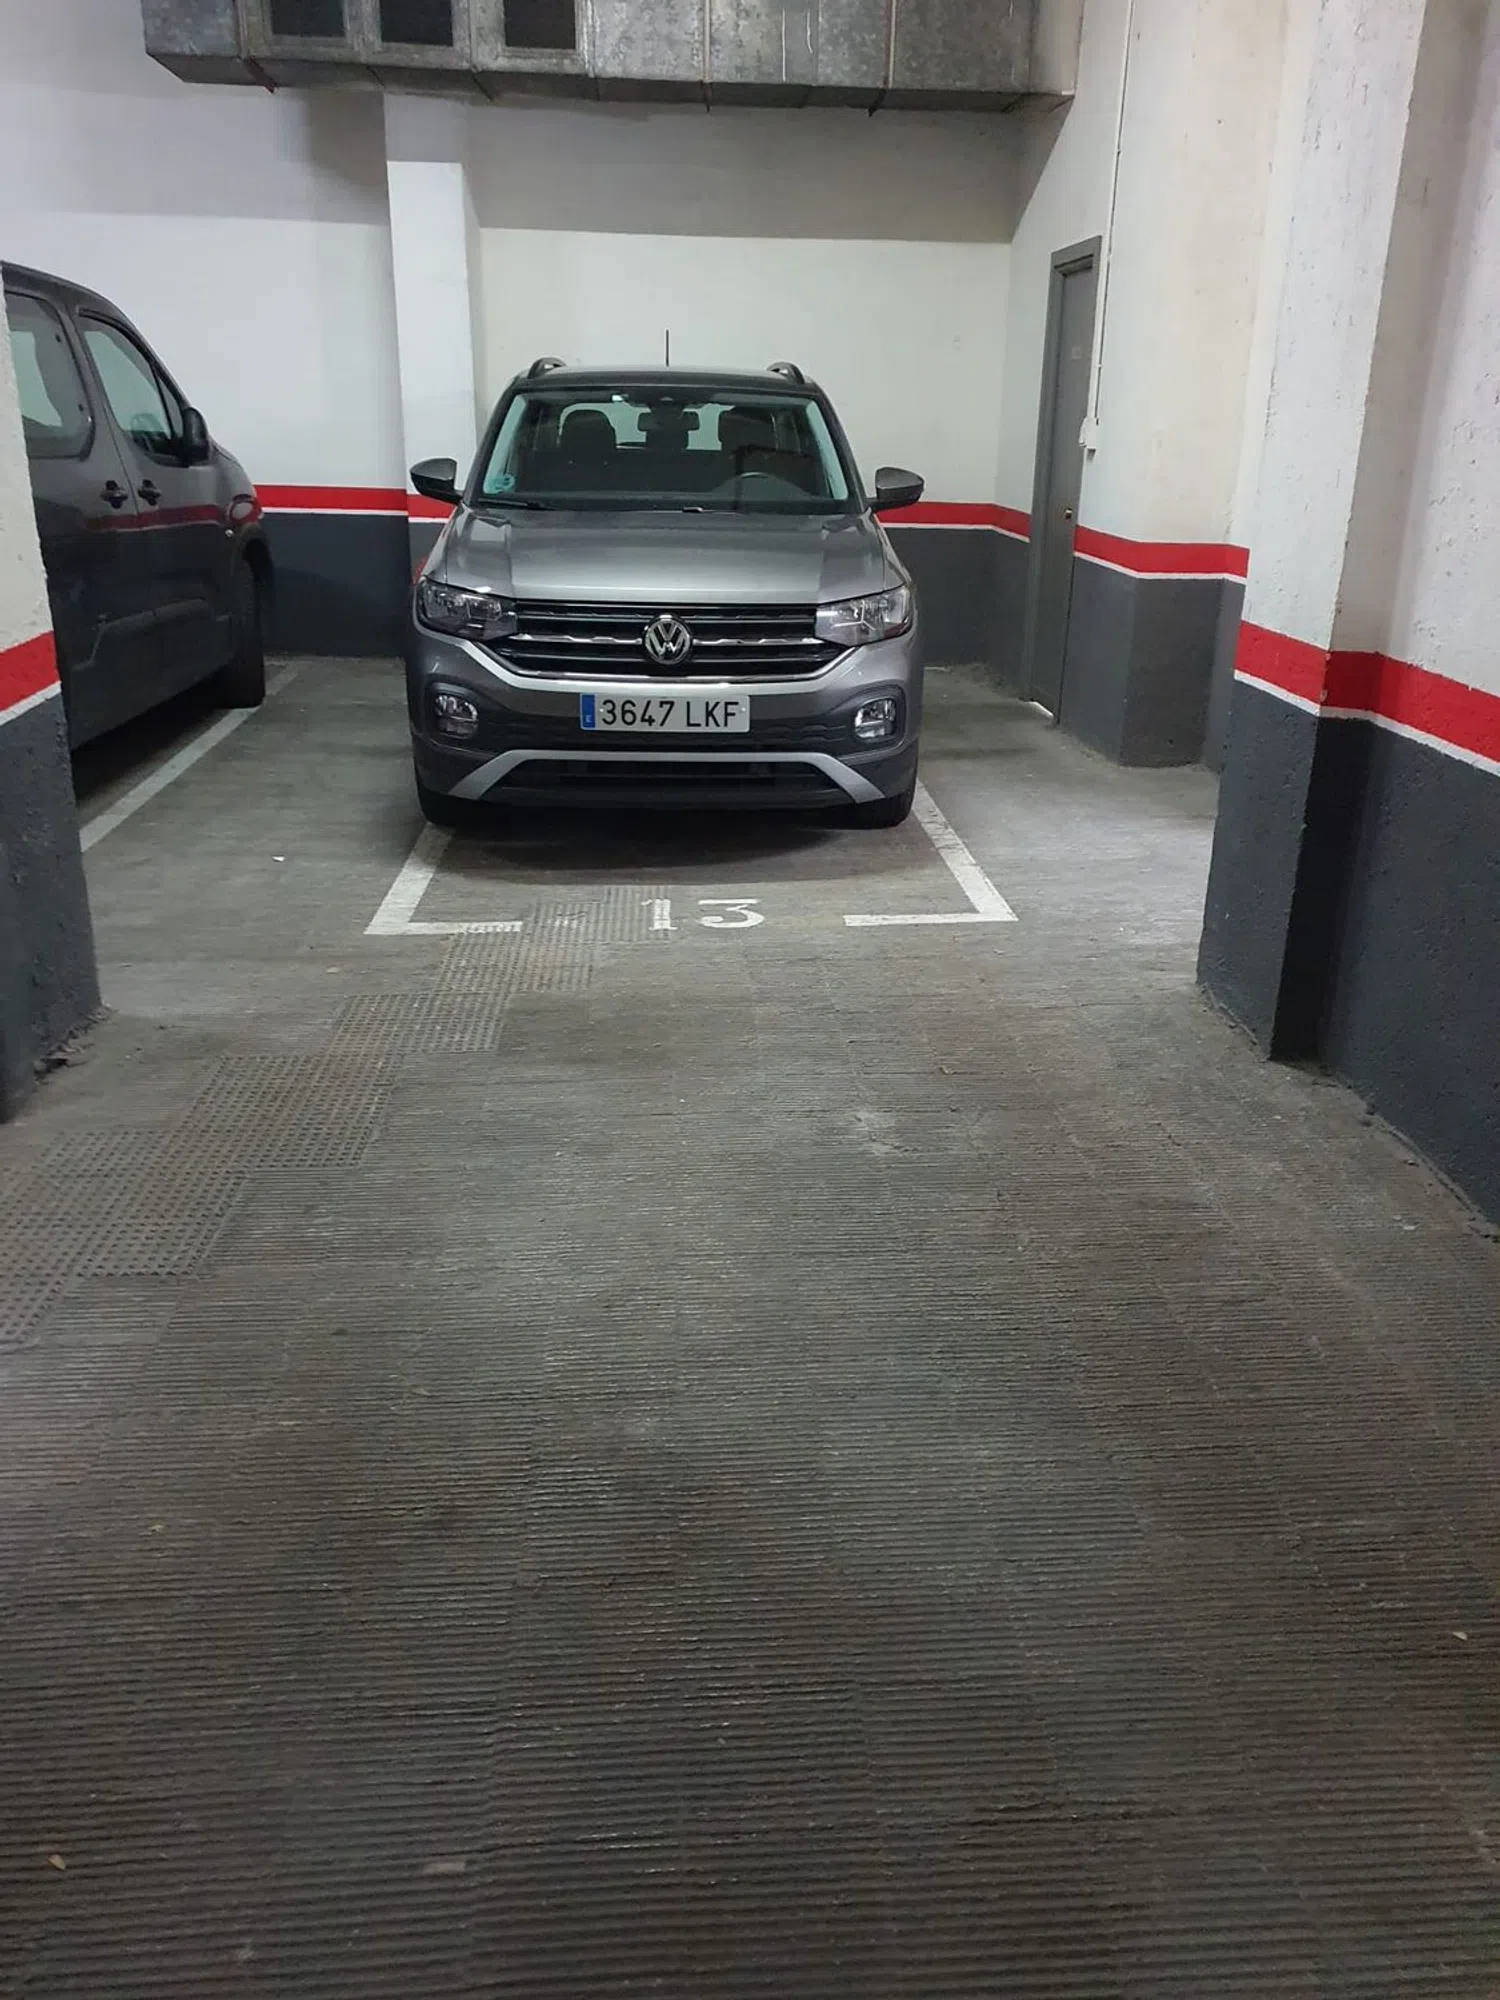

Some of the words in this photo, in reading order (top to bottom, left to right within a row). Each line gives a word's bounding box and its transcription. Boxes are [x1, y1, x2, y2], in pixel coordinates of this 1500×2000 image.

[647, 619, 690, 662] VW
[602, 699, 675, 727] 3647
[686, 701, 740, 728] LKF
[641, 899, 765, 930] 13
